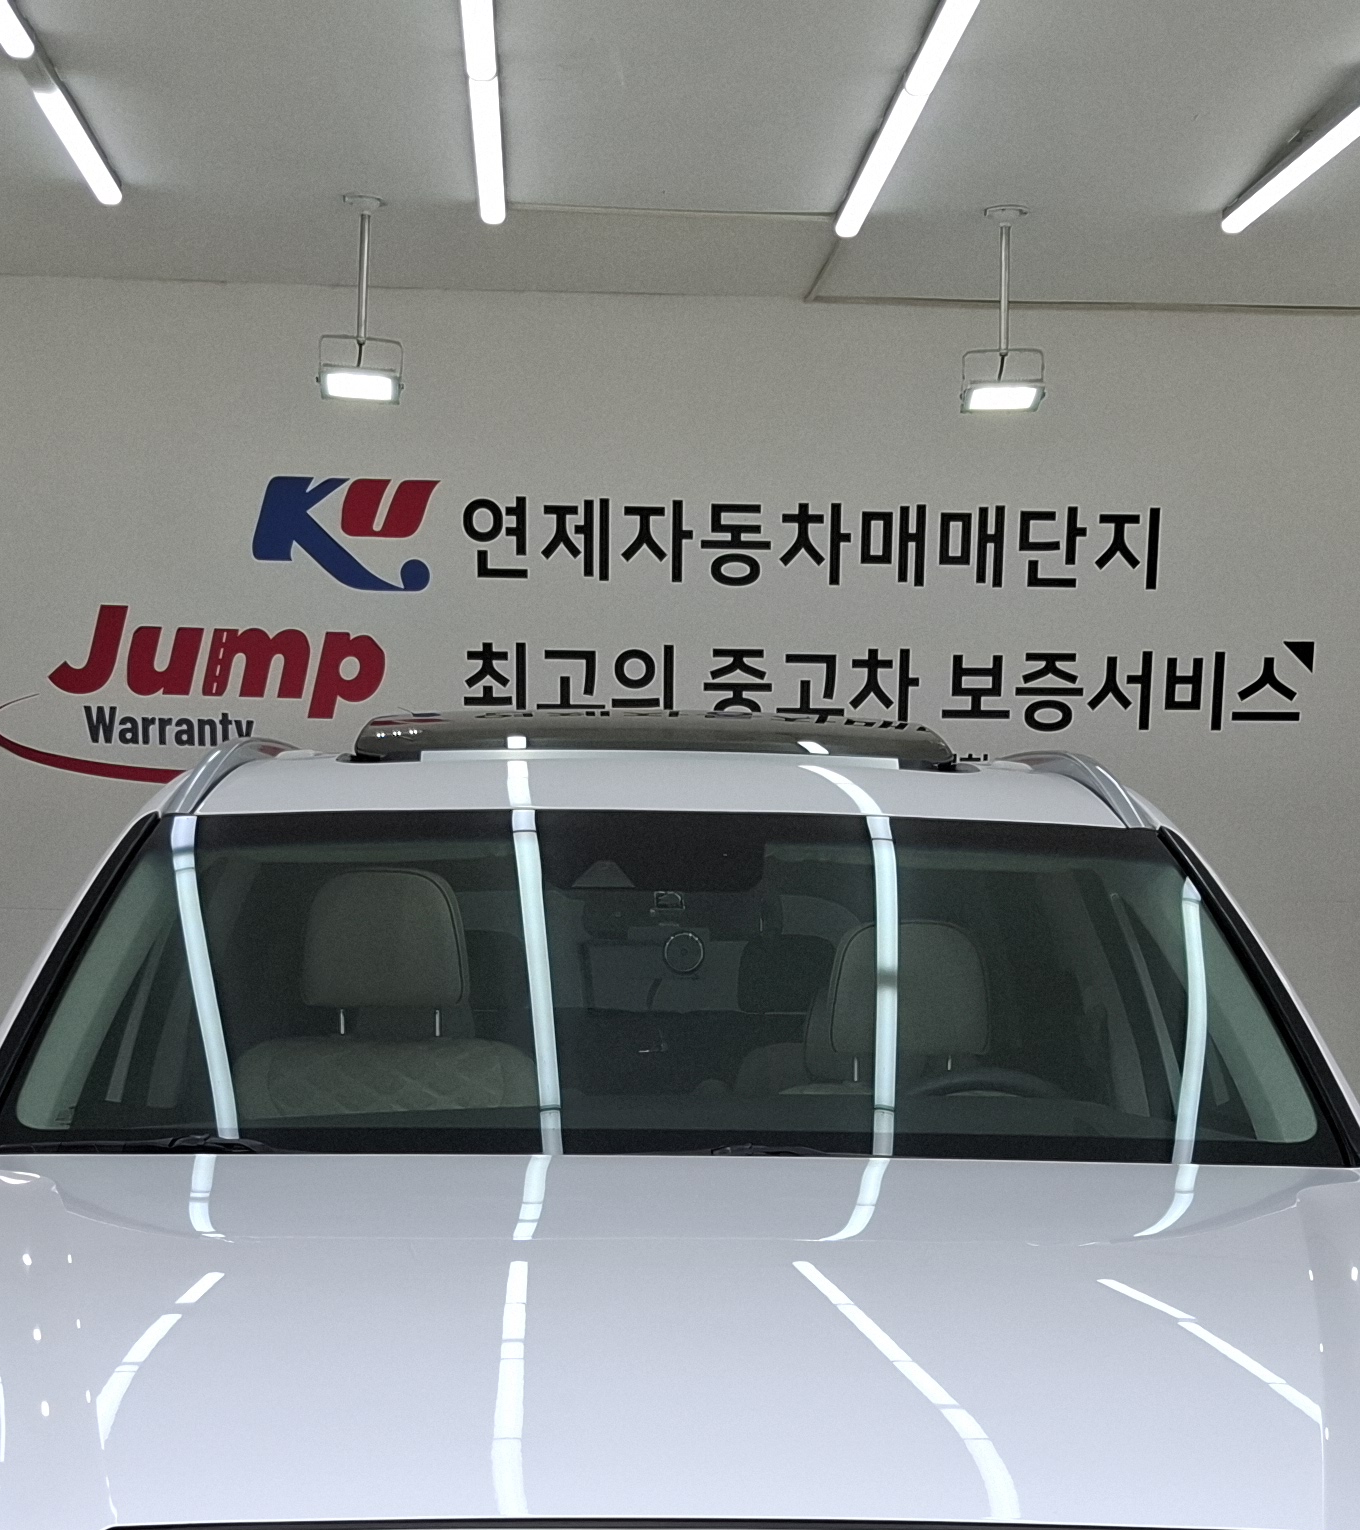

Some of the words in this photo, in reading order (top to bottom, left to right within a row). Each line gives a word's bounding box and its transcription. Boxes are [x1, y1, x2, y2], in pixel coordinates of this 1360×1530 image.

[461, 496, 1162, 590] 연제자동차매매단지
[48, 604, 385, 718] Jump
[463, 642, 674, 711] 최고의
[703, 648, 919, 722] 중고차
[941, 651, 1300, 732] 보증서비스
